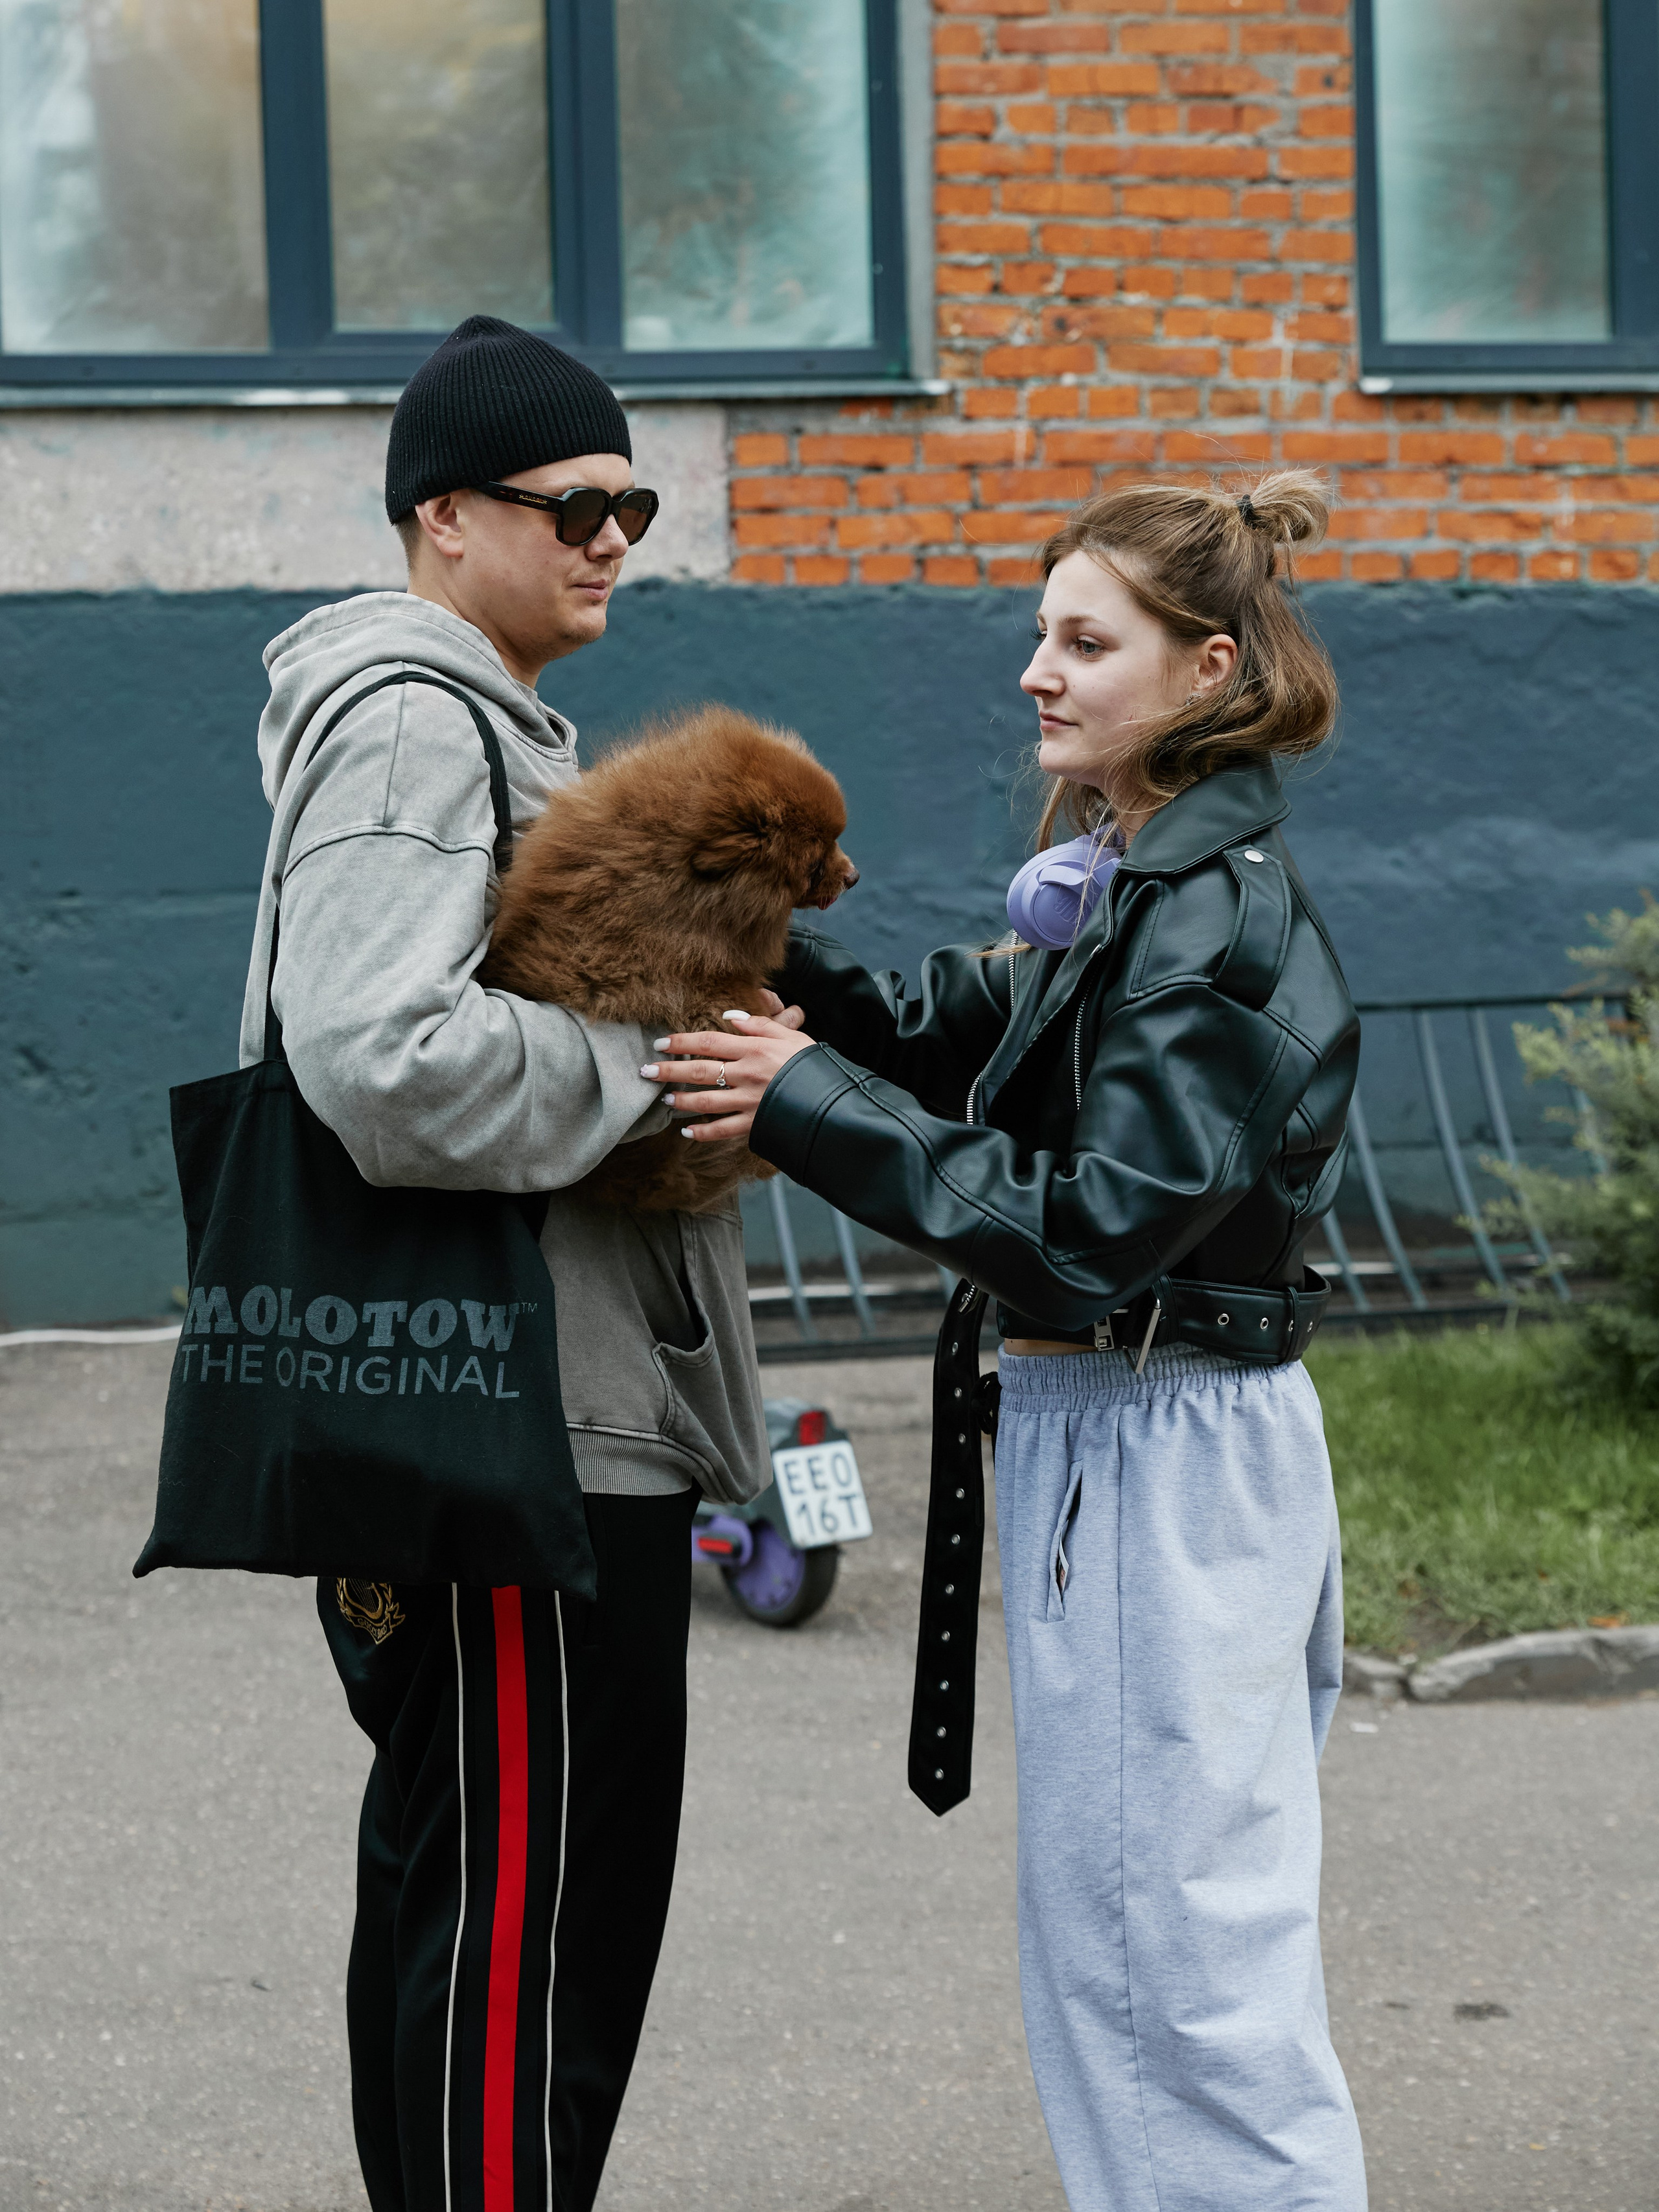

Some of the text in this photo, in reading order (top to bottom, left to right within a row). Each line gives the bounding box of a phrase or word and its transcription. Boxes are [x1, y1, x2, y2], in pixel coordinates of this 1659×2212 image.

[184, 1285, 519, 1351] MOLOTOW
[181, 1344, 520, 1399] THE ORIGINAL
